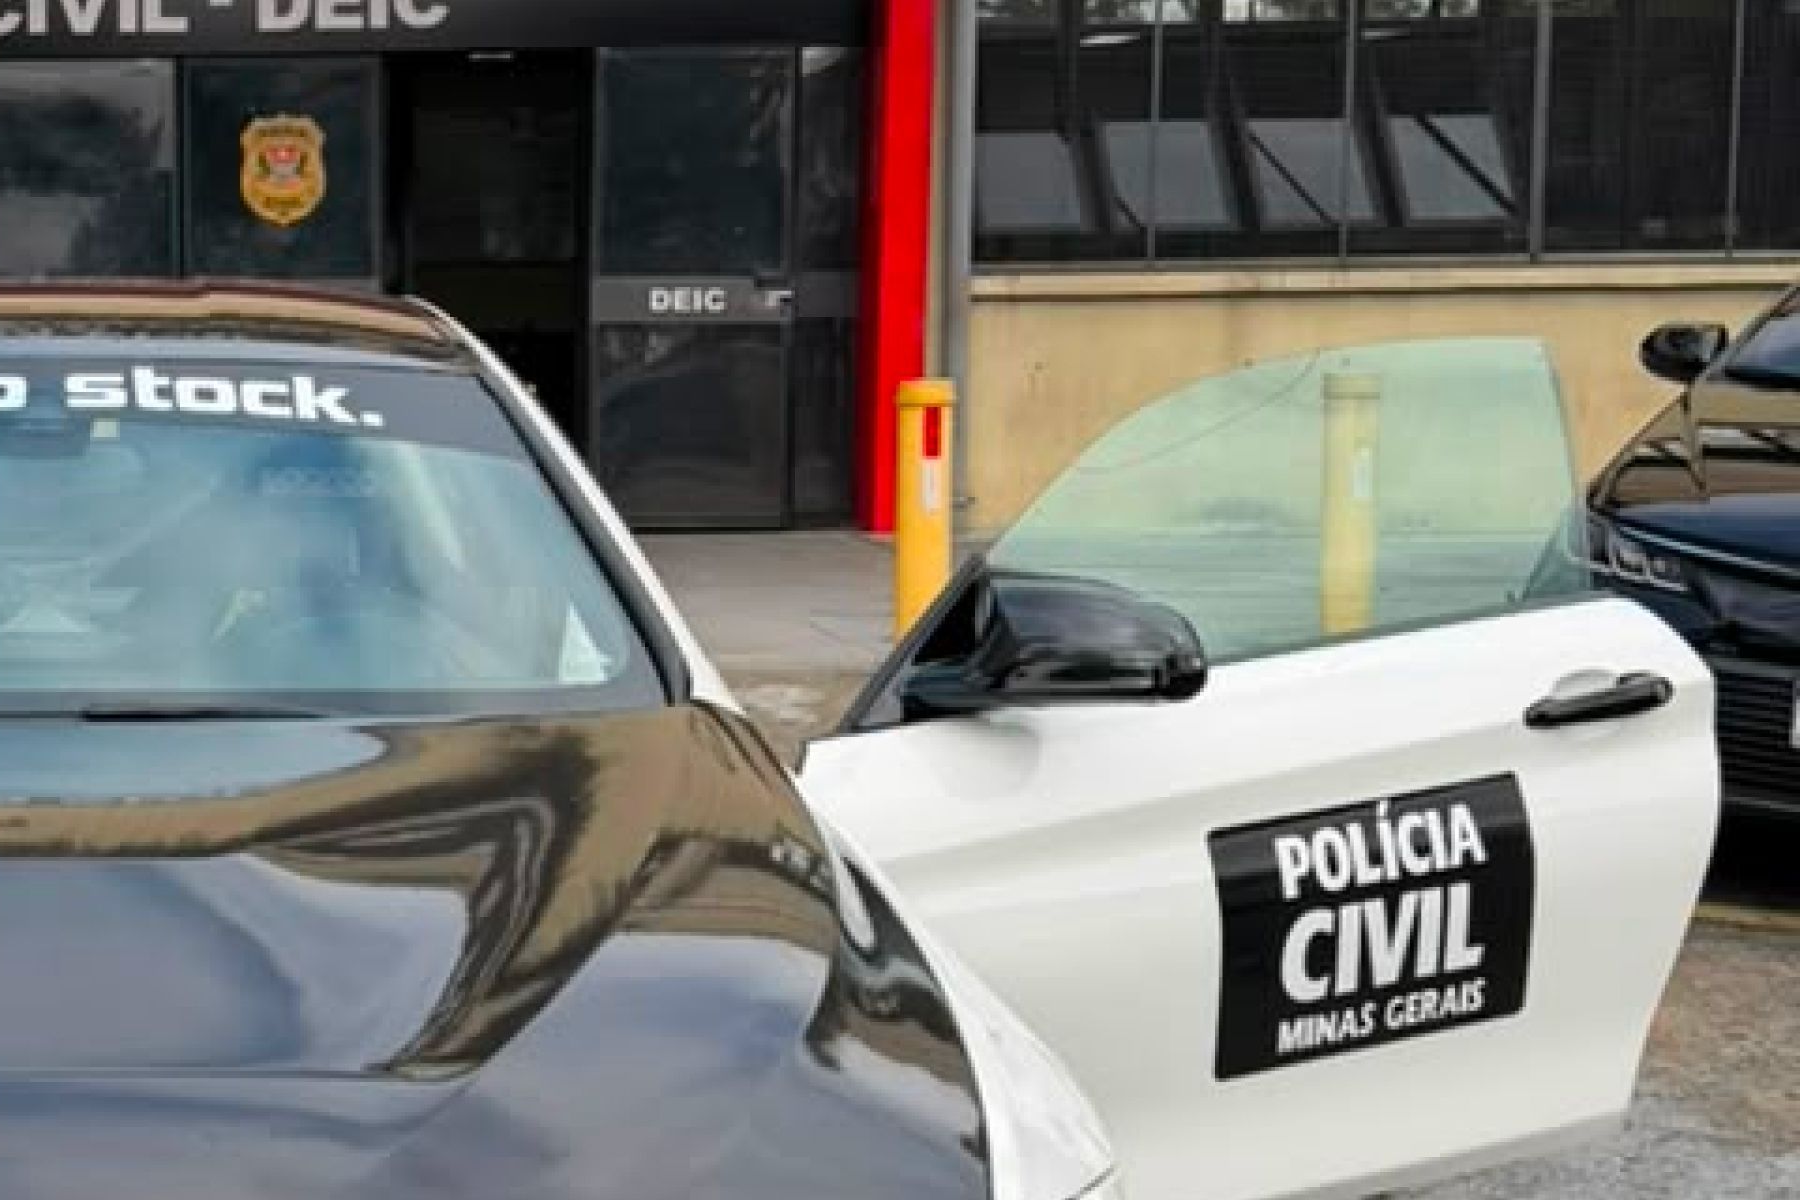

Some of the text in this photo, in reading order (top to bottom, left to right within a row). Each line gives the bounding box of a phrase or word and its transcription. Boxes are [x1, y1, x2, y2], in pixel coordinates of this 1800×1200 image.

[254, 0, 450, 32] DEIC
[649, 286, 728, 313] DEIC
[62, 366, 387, 428] stock.
[1272, 799, 1488, 901] POLÍCIA
[1280, 880, 1487, 1003] CIVIL
[1277, 976, 1488, 1055] MINAS GERAIS
